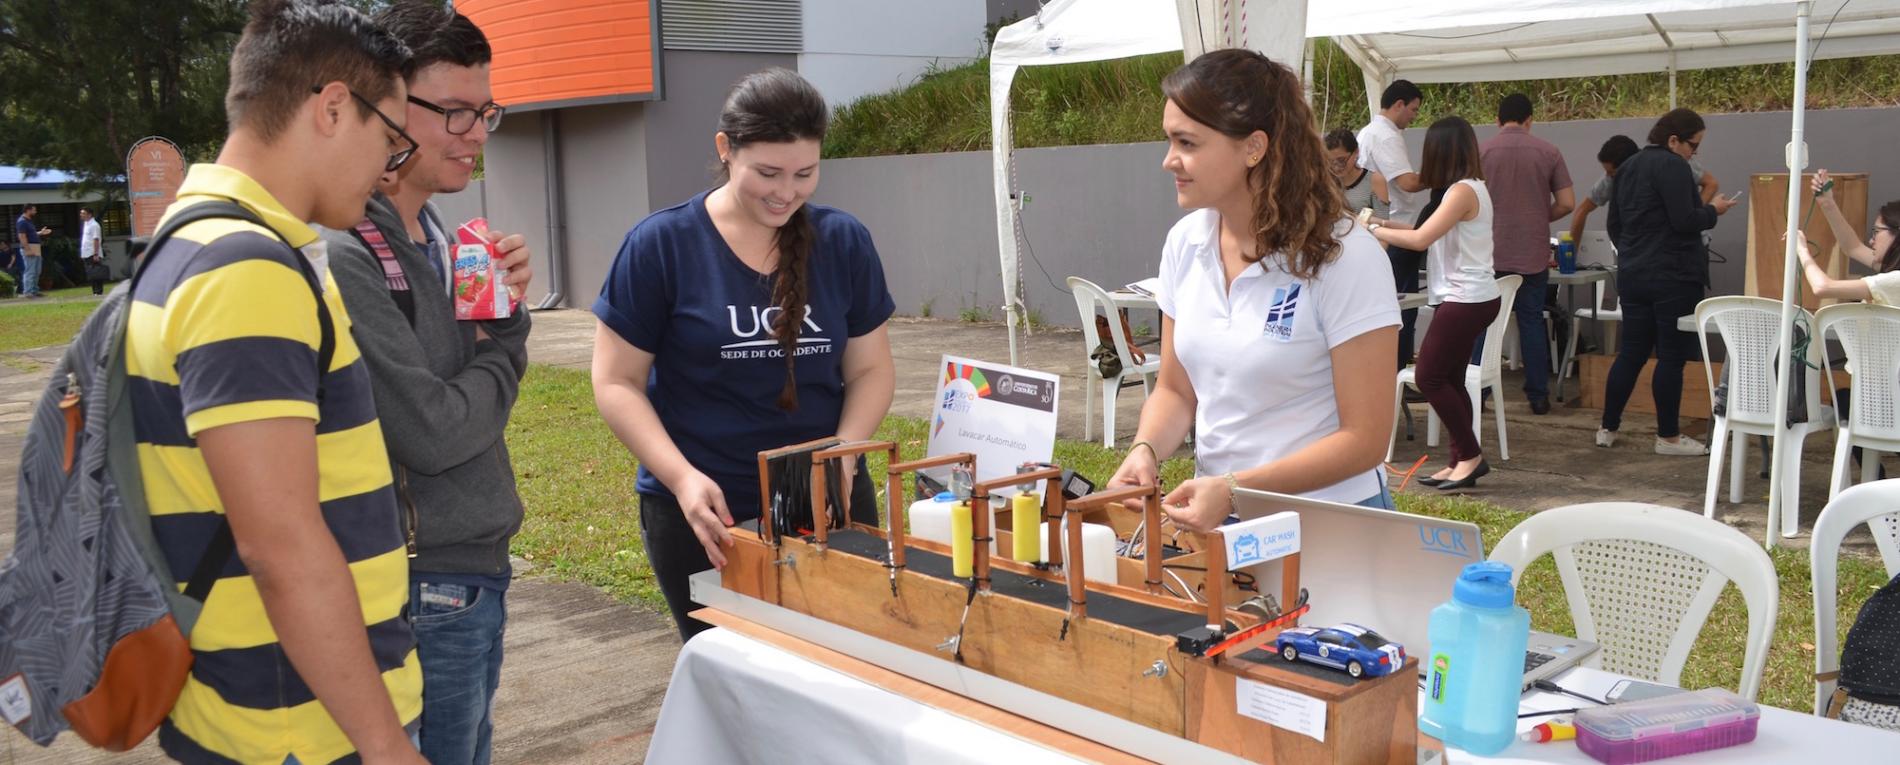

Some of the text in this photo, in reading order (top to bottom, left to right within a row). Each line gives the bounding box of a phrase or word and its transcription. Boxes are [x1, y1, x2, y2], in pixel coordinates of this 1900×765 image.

[727, 304, 823, 338] UCR
[720, 344, 832, 360] SEDE DE OCIDENTE
[958, 427, 985, 441] Lavacar
[1263, 529, 1296, 545] CAR WASH
[1417, 524, 1468, 552] UCR
